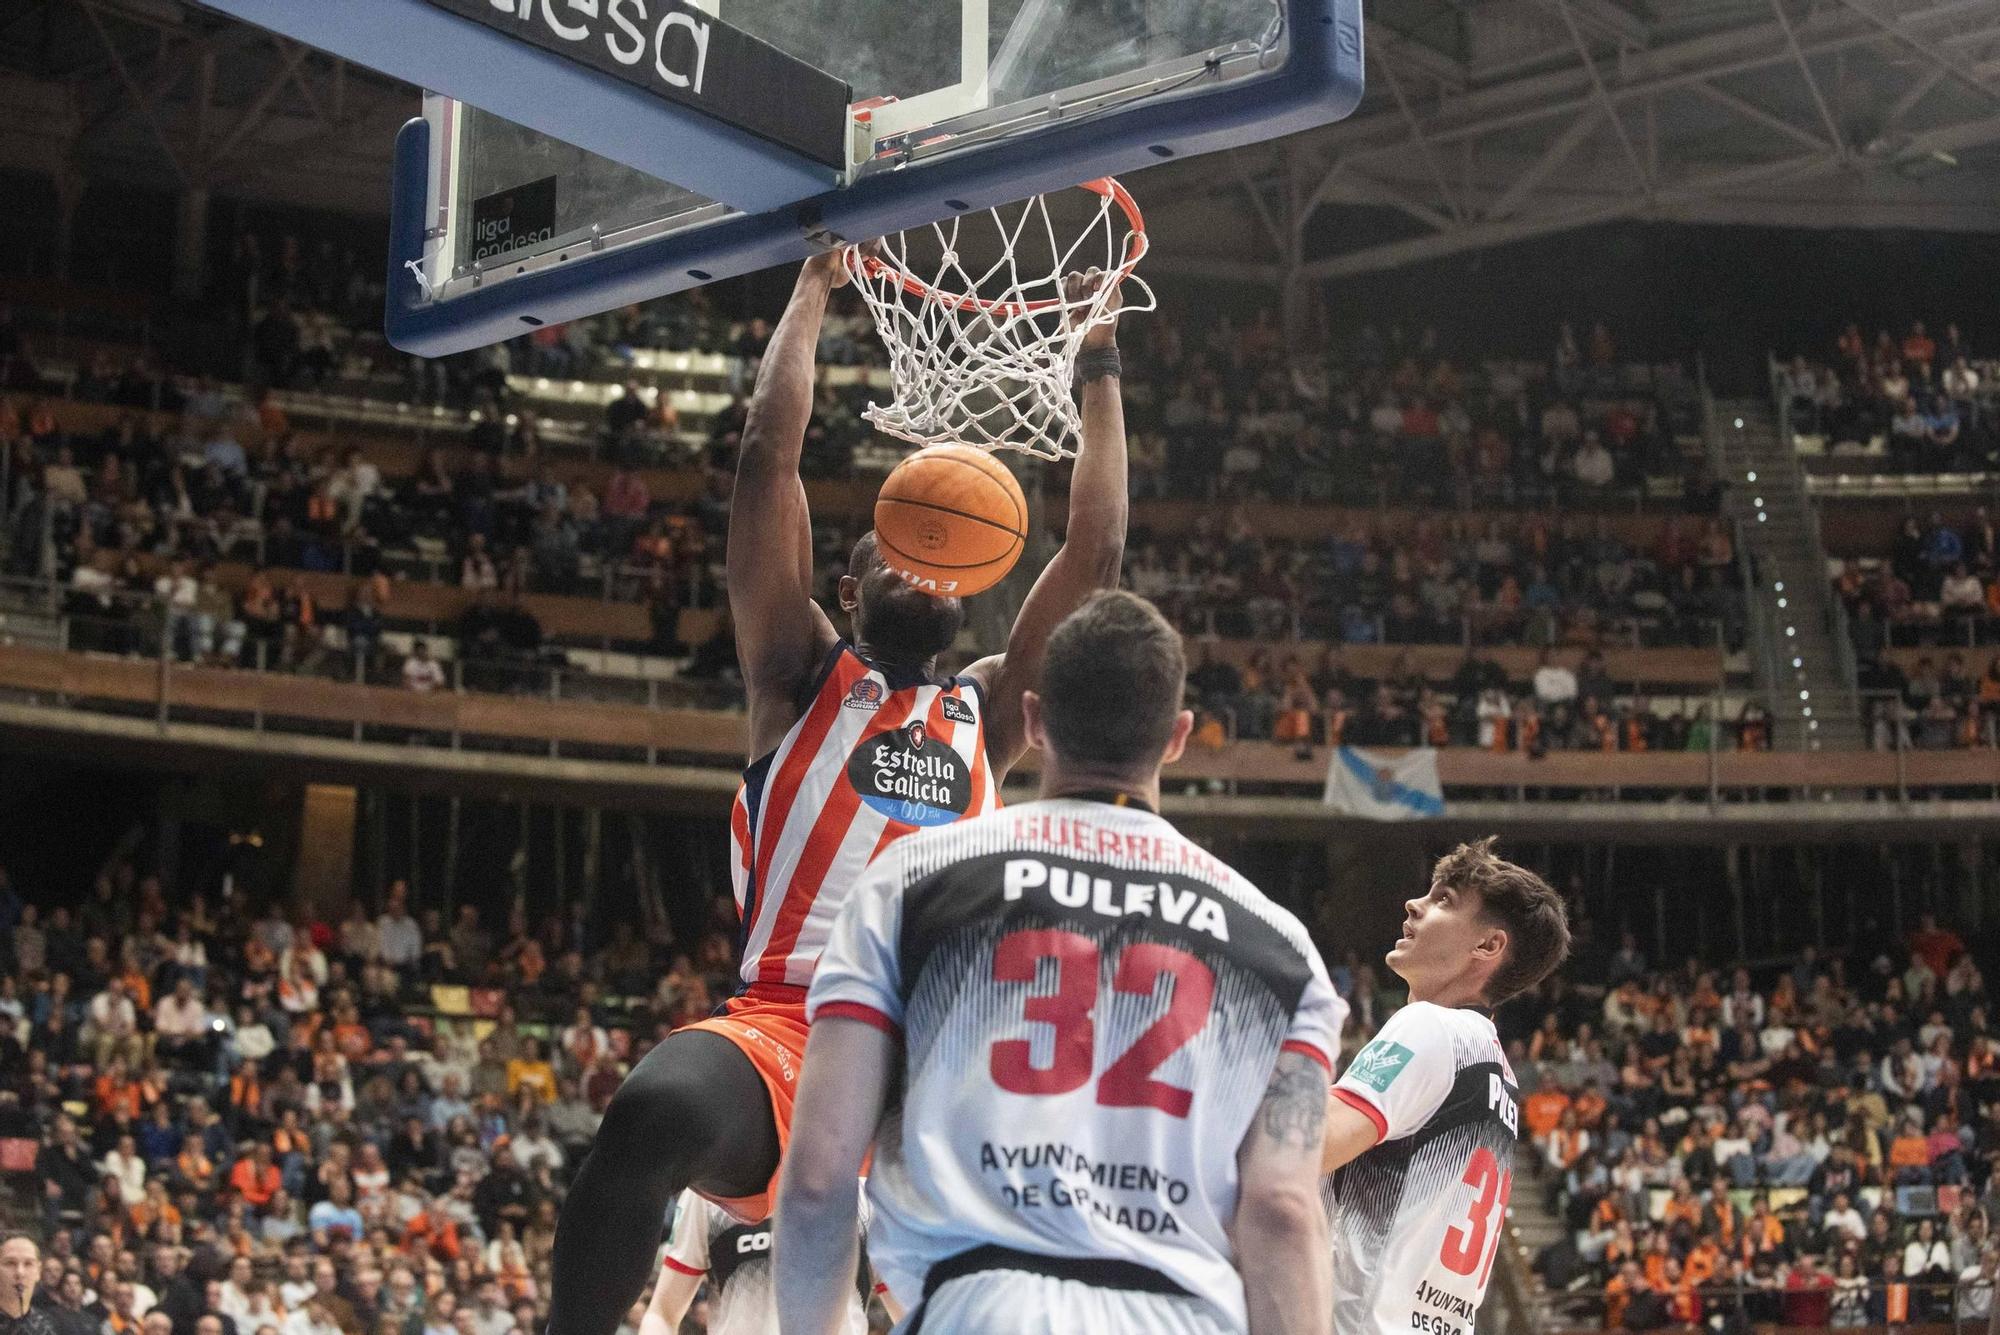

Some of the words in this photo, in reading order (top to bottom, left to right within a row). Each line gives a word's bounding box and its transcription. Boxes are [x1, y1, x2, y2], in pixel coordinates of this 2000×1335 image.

[476, 227, 551, 261] endesa
[477, 216, 510, 242] liga
[945, 702, 960, 712] liga
[872, 744, 955, 781] Estrella
[874, 768, 951, 805] Galicia
[1004, 859, 1229, 942] PULEVA
[990, 928, 1215, 1118] 32
[981, 1141, 1189, 1205] AYUNAMIENO
[1051, 1178, 1180, 1235] GRNADA
[1412, 1311, 1430, 1332] DE
